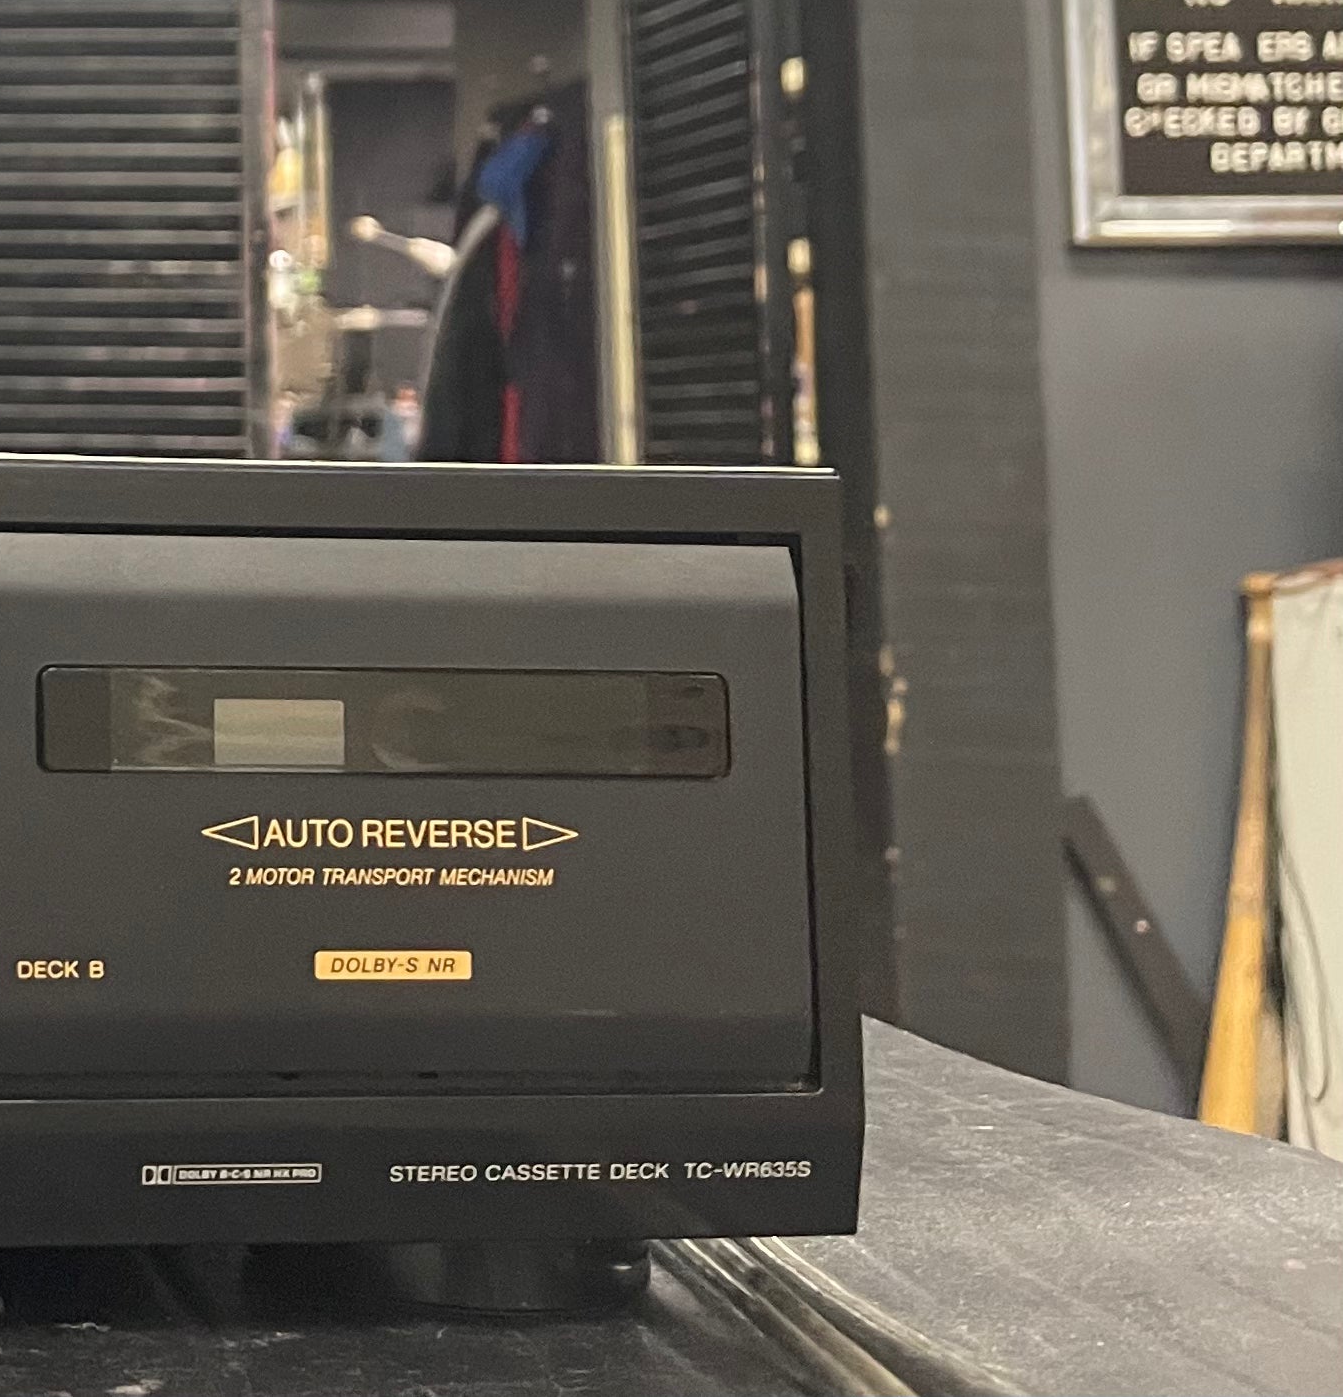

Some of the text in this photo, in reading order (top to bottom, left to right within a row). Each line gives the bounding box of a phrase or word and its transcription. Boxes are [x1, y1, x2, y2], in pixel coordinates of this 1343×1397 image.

[1128, 31, 1160, 63] IF
[262, 818, 518, 849] AUTO REVERSE
[228, 867, 554, 888] 2 MOTOR TRANSPORT MECHANISM
[16, 959, 106, 980] DECK B
[329, 956, 457, 975] DOLBY-S NR
[178, 1169, 218, 1180] DOLBY
[292, 1167, 317, 1179] PRO
[389, 1161, 812, 1183] STEREO CASSETTE DECK TC-WR635S
